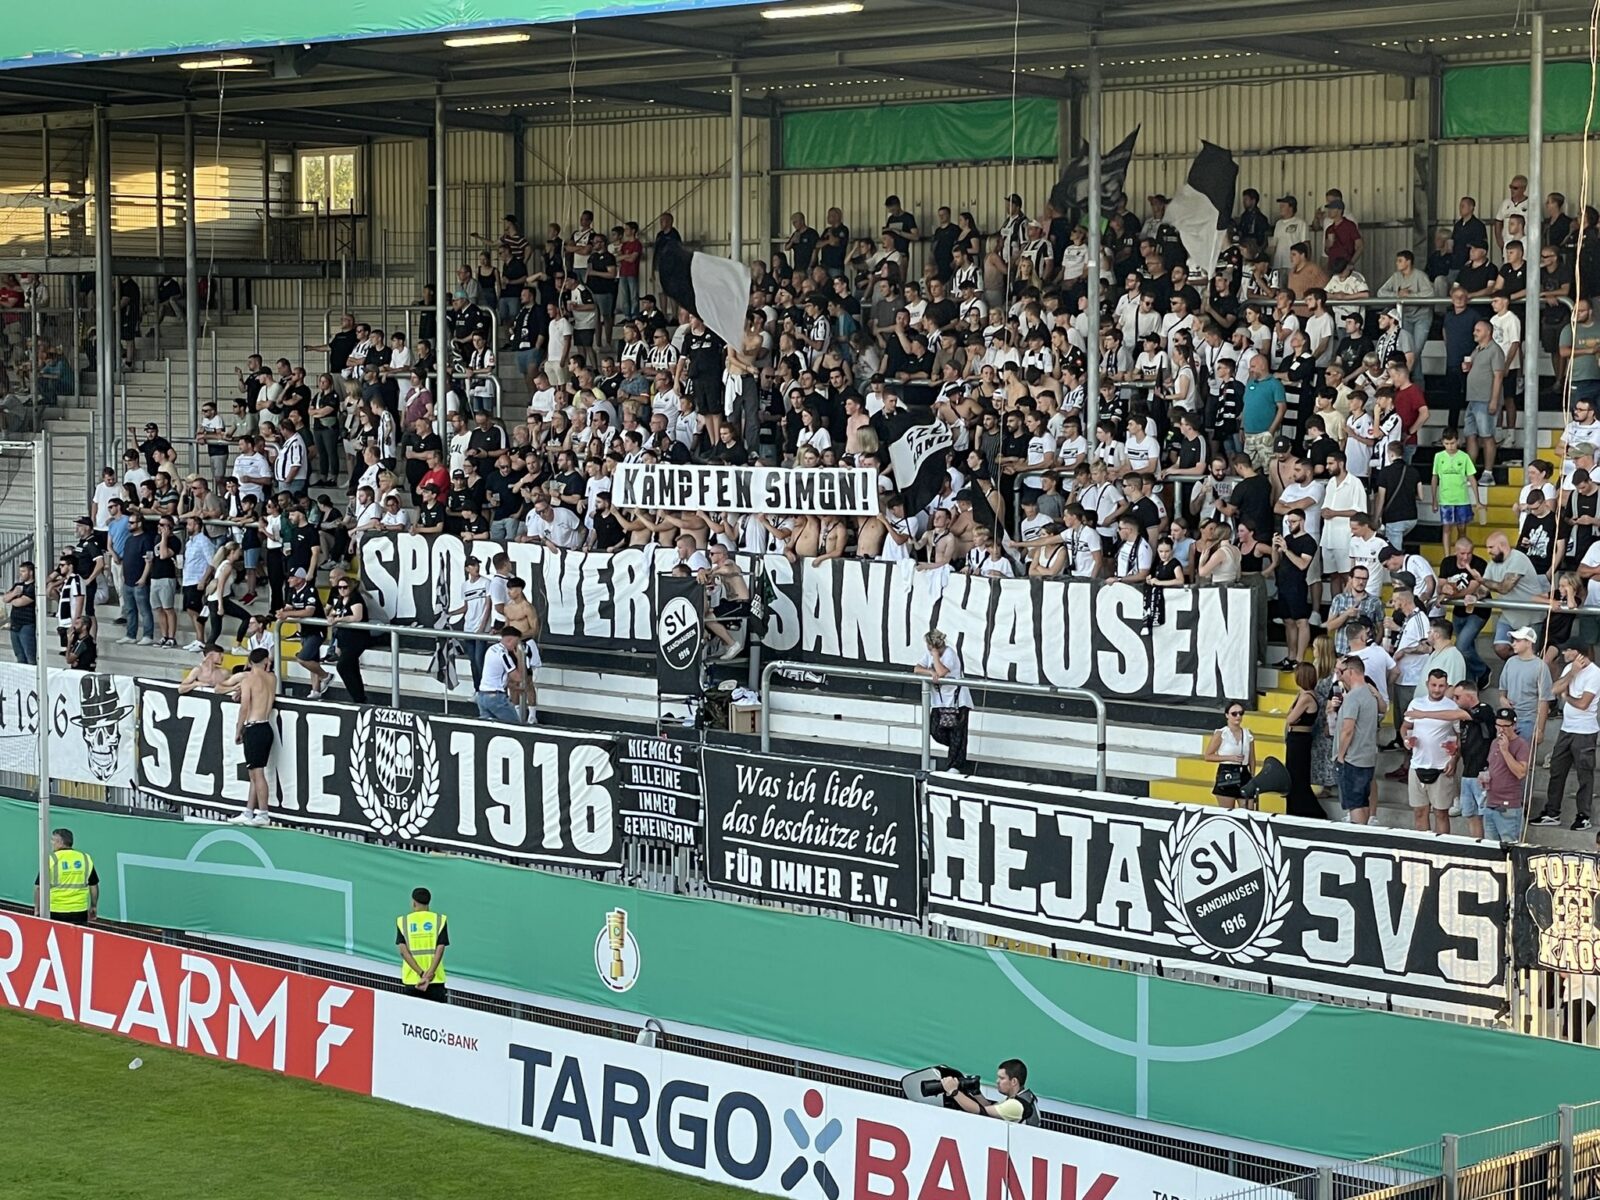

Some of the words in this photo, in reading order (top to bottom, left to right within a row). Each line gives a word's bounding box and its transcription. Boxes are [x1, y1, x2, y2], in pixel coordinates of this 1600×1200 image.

[623, 464, 754, 509] KÄMPFEN
[765, 471, 869, 511] SIMON!
[664, 604, 686, 636] SV
[761, 553, 1252, 700] SANDHAUSEN
[666, 629, 696, 653] SANDHAUSEN
[678, 647, 690, 660] 1916
[15, 688, 69, 738] 196
[374, 708, 414, 728] SZENE
[628, 739, 682, 764] NIEMALS
[141, 689, 341, 816] SZENE
[450, 731, 614, 855] 1916
[631, 765, 682, 790] ALLEINE
[383, 793, 409, 811] 1916
[638, 791, 677, 815] IMMER
[735, 764, 781, 798] Was
[786, 767, 817, 803] ich
[823, 770, 879, 816] liebe,
[623, 816, 695, 845] GEMEINSAM
[722, 799, 757, 835] das
[760, 804, 860, 851] beschütze
[864, 822, 898, 857] ich
[1190, 830, 1238, 886] SV
[1528, 854, 1600, 889] TOTA
[724, 847, 763, 887] FÜR
[770, 858, 842, 899] IMMER
[850, 871, 898, 908] E.V.
[928, 790, 1152, 934] HEJA
[1301, 851, 1500, 985] SVS
[1195, 880, 1260, 918] SANDHAUSEN
[1221, 913, 1247, 935] 1916
